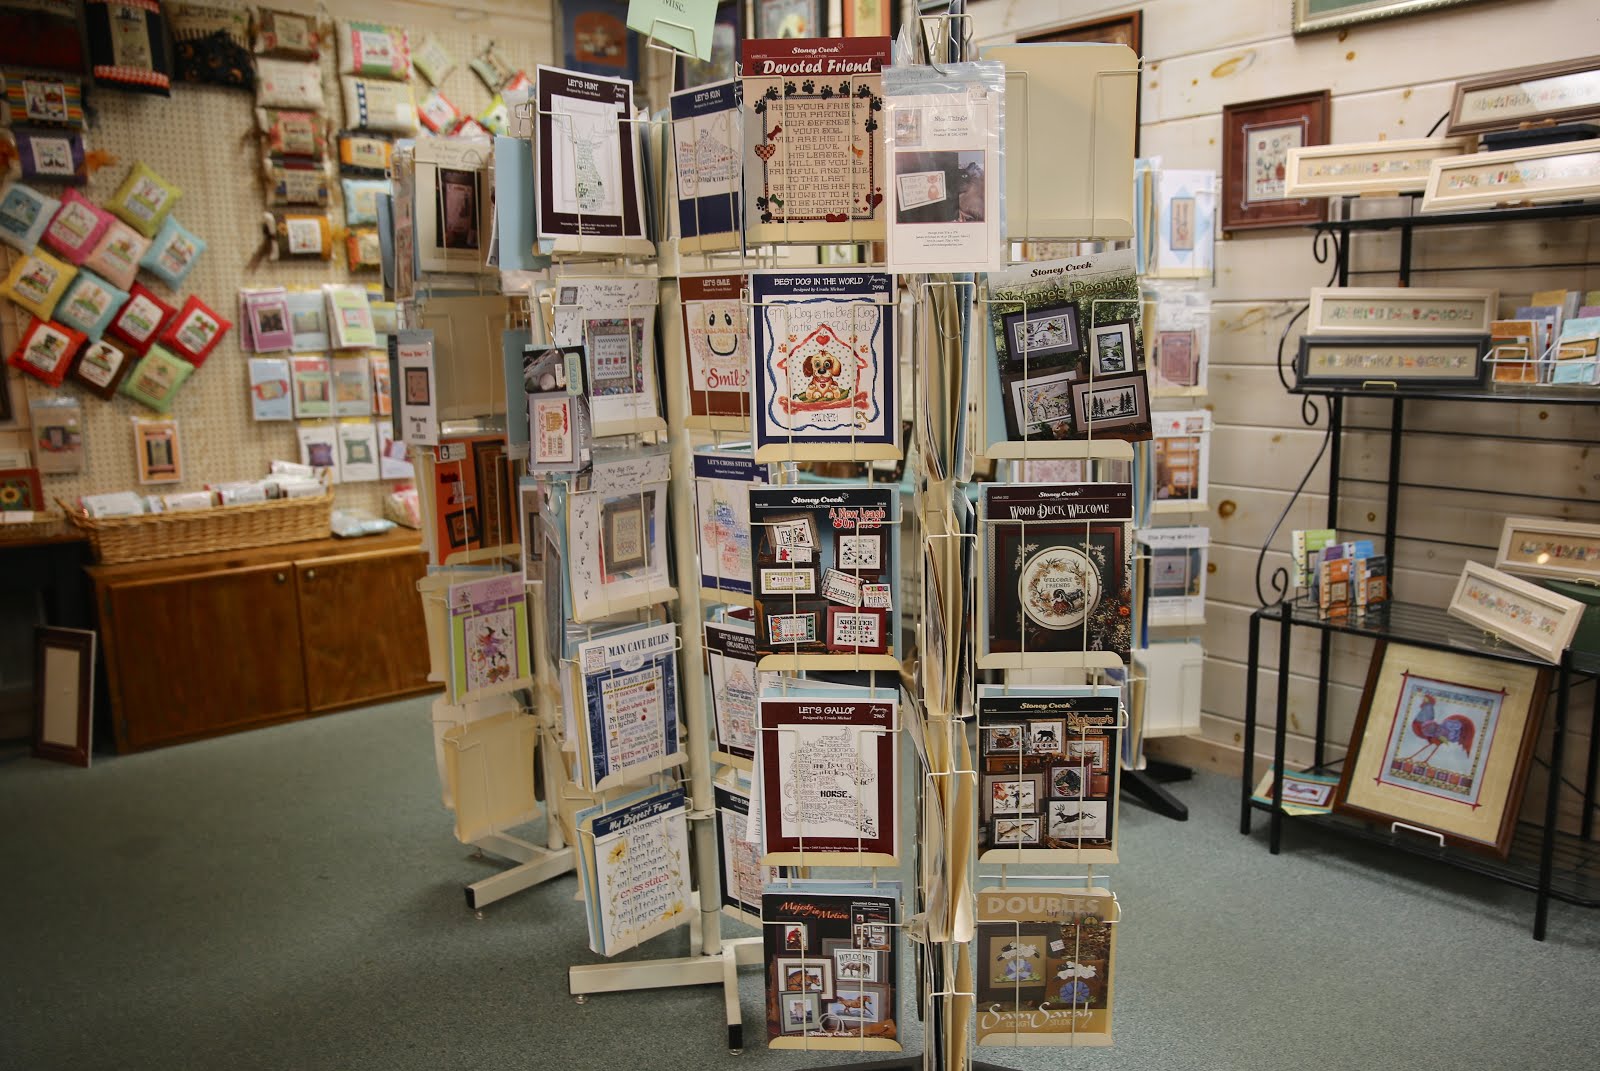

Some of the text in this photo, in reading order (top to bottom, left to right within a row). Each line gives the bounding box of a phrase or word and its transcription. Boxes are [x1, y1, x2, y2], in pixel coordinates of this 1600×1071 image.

[764, 58, 872, 74] Devoted Friend
[567, 78, 599, 91] LET'S HUNT
[694, 92, 709, 102] LET'S
[1030, 262, 1092, 278] Stoney Creek
[774, 278, 794, 286] BEST
[795, 278, 812, 286] DOG
[996, 277, 1133, 301] Nature's Beauty
[823, 308, 834, 318] the
[829, 508, 885, 518] A New Leash
[1010, 504, 1109, 519] WOOD DUCK WELCOME
[608, 633, 669, 657] MAN CAVE RULES
[623, 676, 639, 685] CAVE
[1067, 712, 1114, 725] Nature's
[641, 744, 650, 753] TV
[609, 820, 621, 831] My
[623, 808, 652, 826] Biggest
[652, 801, 672, 814] Fear
[644, 873, 670, 889] stitch
[780, 902, 813, 915] Majesty
[818, 910, 849, 920] Motion
[987, 896, 1099, 914] DOUBLES
[839, 953, 872, 964] WELCOME
